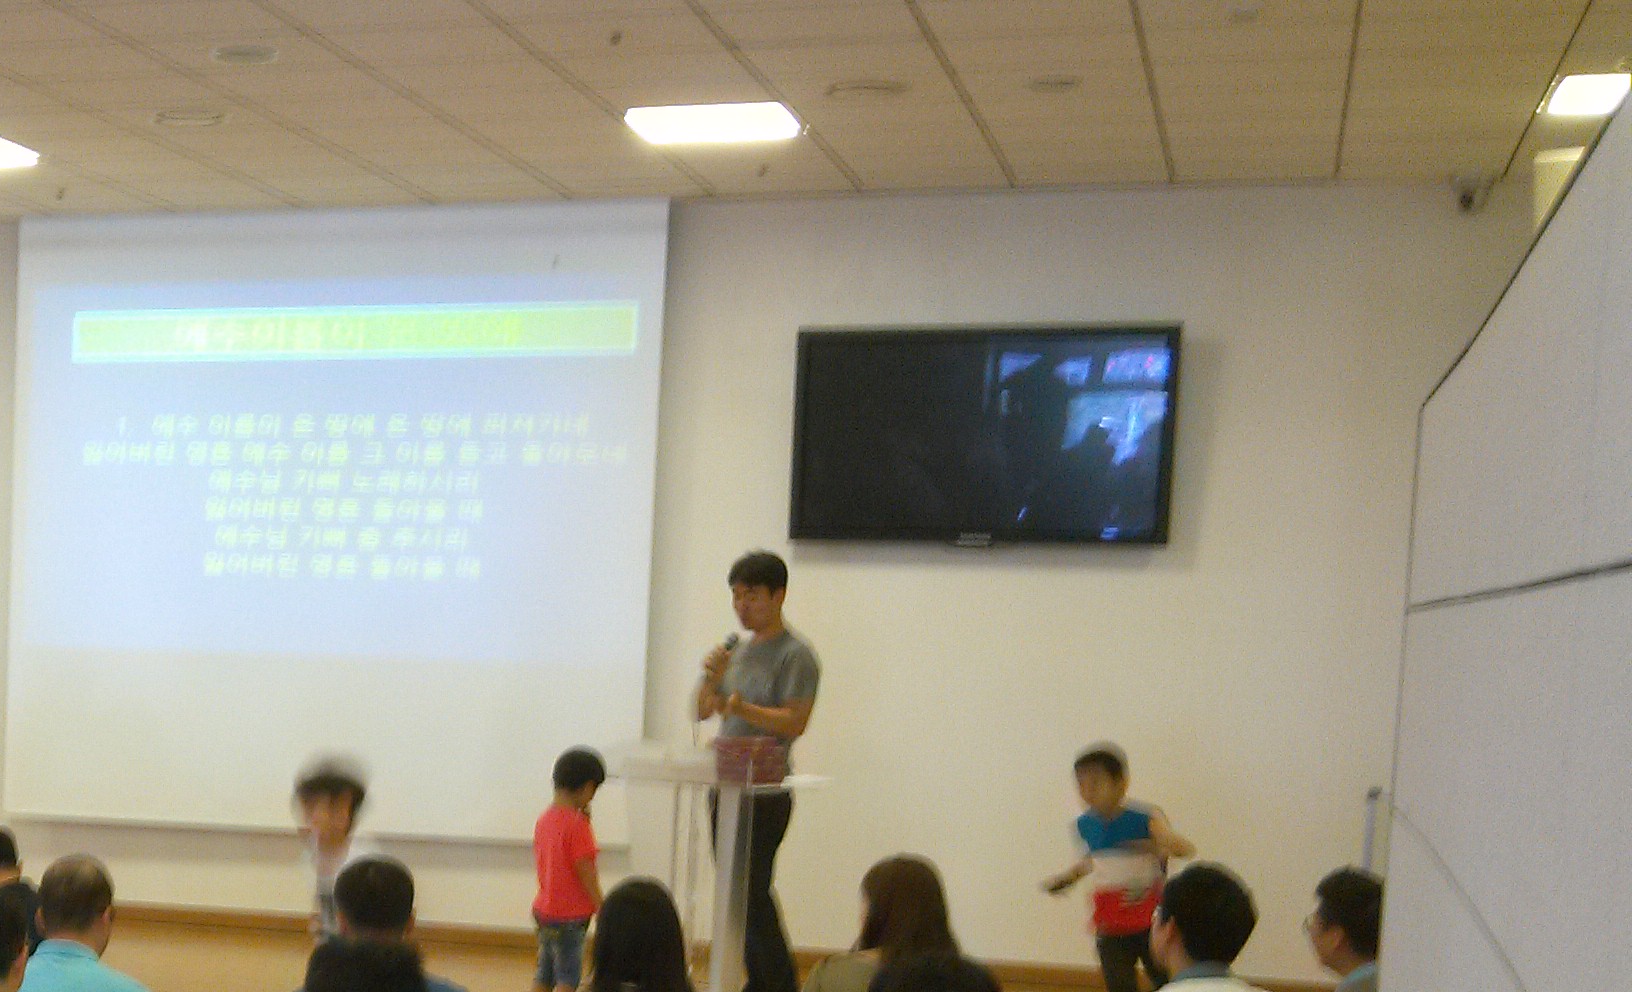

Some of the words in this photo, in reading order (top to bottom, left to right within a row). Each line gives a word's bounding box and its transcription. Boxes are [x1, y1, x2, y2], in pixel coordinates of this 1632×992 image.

[151, 413, 200, 438] 예수
[208, 413, 282, 438] 이름이
[82, 440, 174, 466] 잃어버린
[186, 440, 232, 466] 영혼
[242, 440, 291, 466] 예수
[300, 440, 349, 466] 이름
[395, 440, 445, 466] 이름
[208, 469, 282, 494] 예수님
[204, 496, 302, 522] 잃어버린
[215, 524, 288, 549] 예수님
[203, 552, 300, 579] 잃어버린
